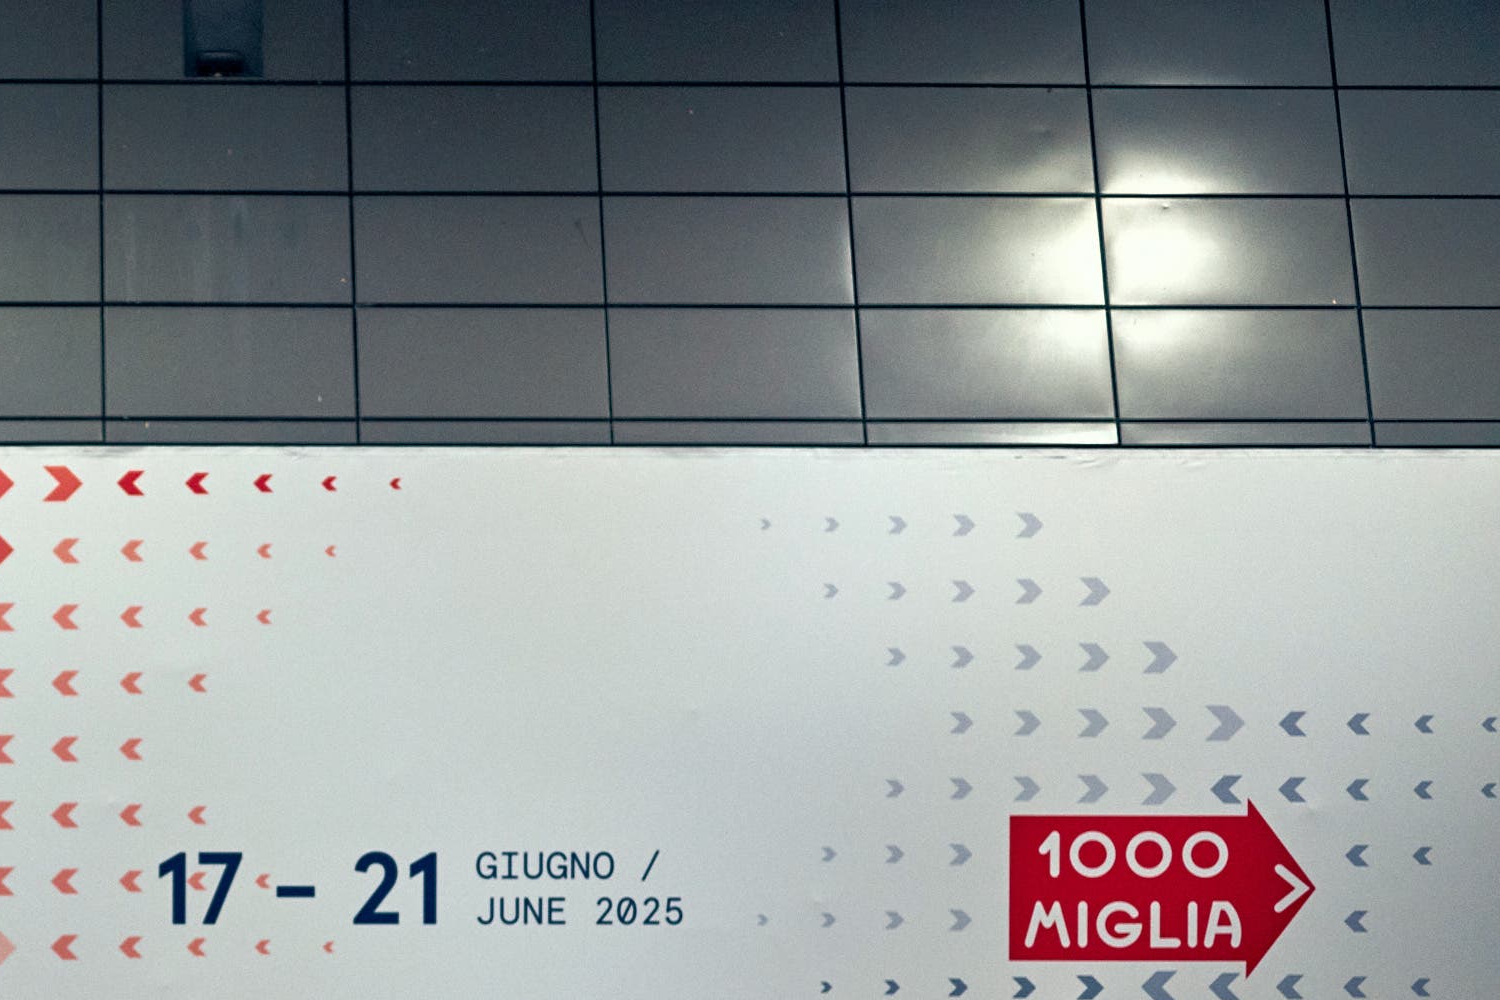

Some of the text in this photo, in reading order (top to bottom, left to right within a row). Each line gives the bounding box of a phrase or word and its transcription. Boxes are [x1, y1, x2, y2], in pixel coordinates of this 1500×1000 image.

[476, 852, 614, 879] GIUGNO
[1039, 831, 1228, 878] 1000
[159, 852, 242, 924] 17
[353, 851, 437, 924] 21
[477, 897, 683, 925] JUNE 2025
[1025, 901, 1241, 948] MIGLIA
